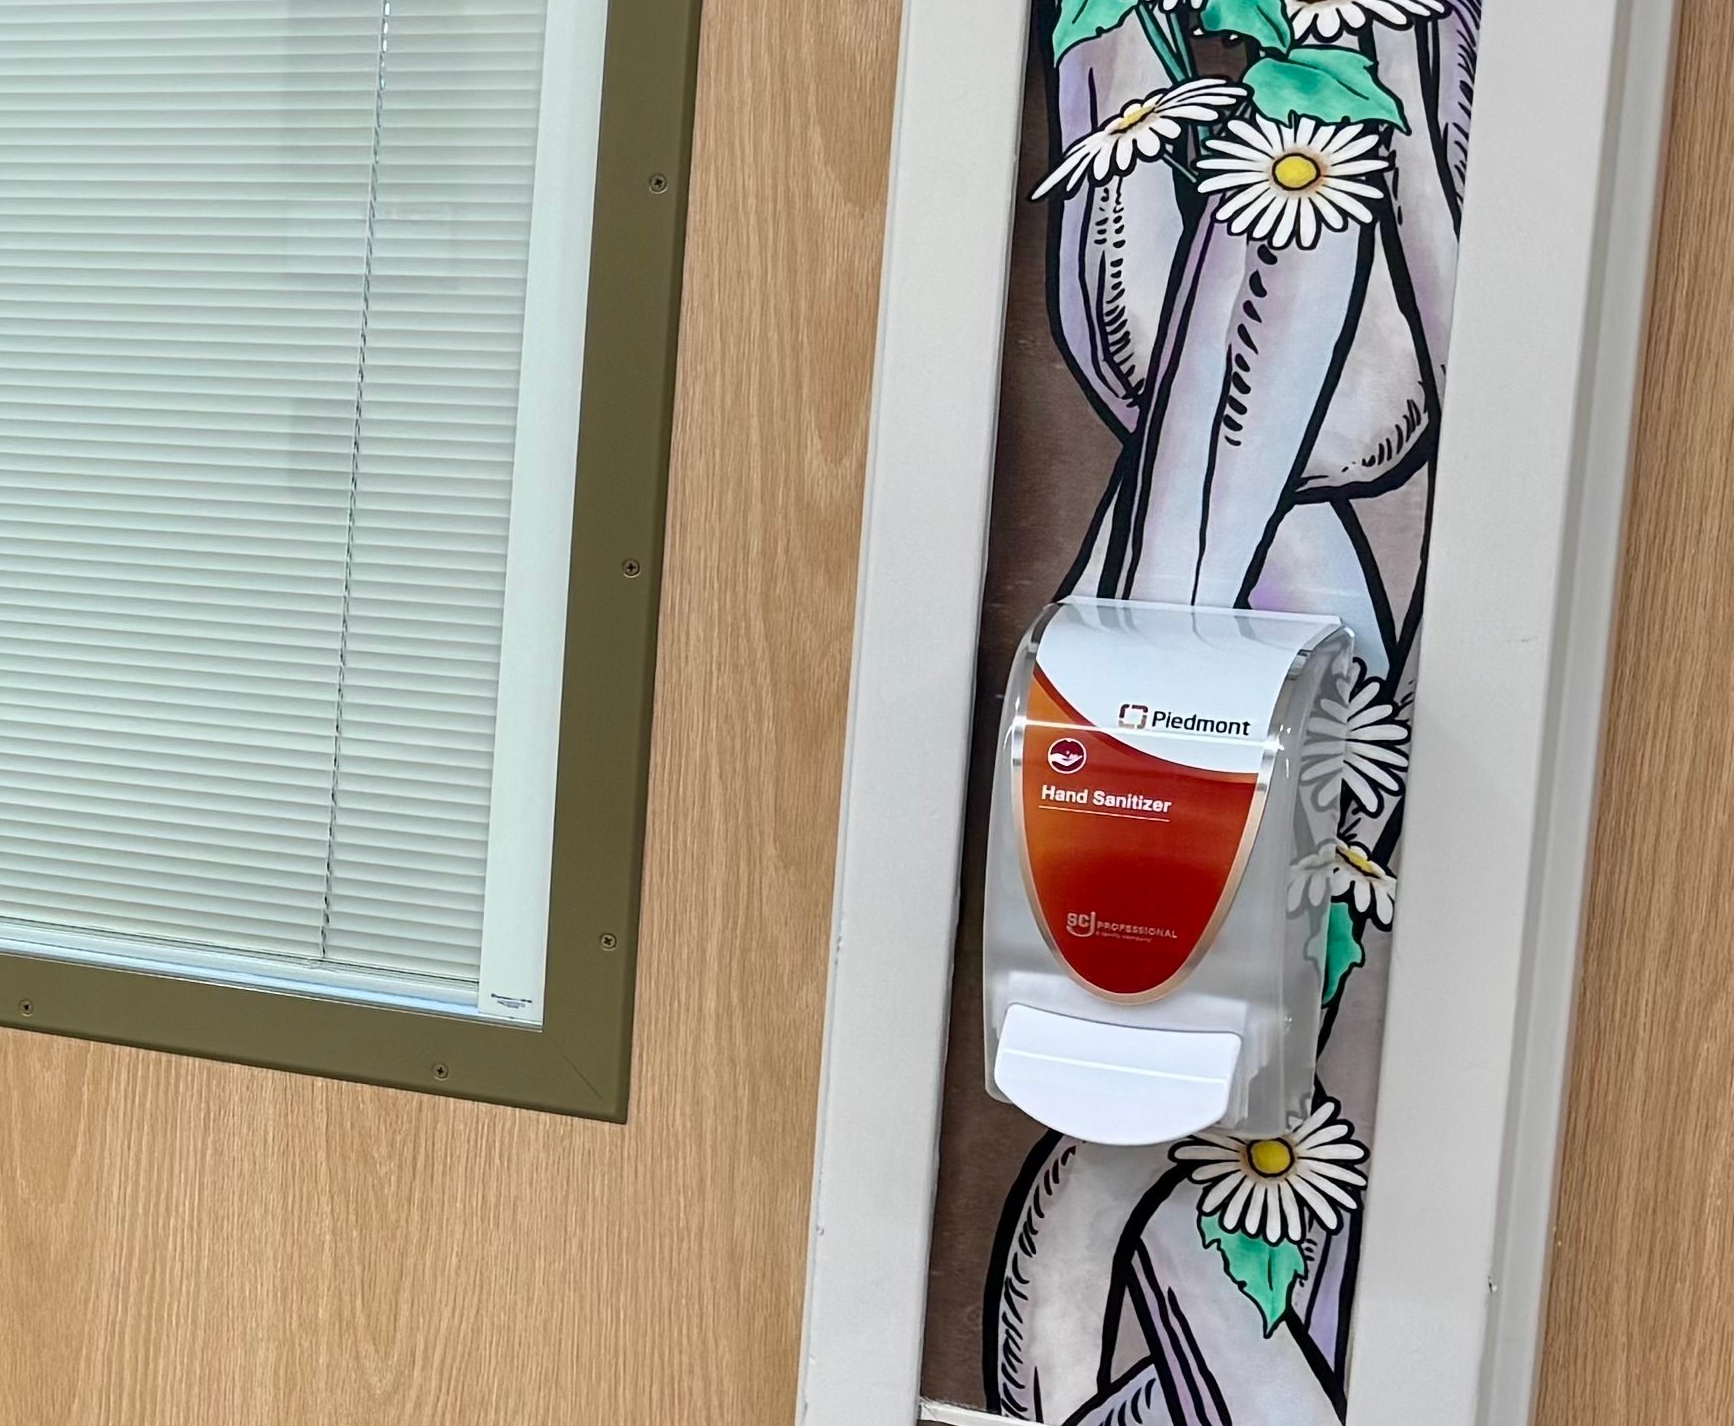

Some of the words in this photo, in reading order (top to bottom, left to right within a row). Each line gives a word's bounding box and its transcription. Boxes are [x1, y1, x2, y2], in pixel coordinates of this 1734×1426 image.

[1151, 710, 1251, 736] Piedmont
[1041, 784, 1088, 804] Hand
[1092, 790, 1172, 813] Sanitizer
[1097, 921, 1177, 938] PROFESSIONAL
